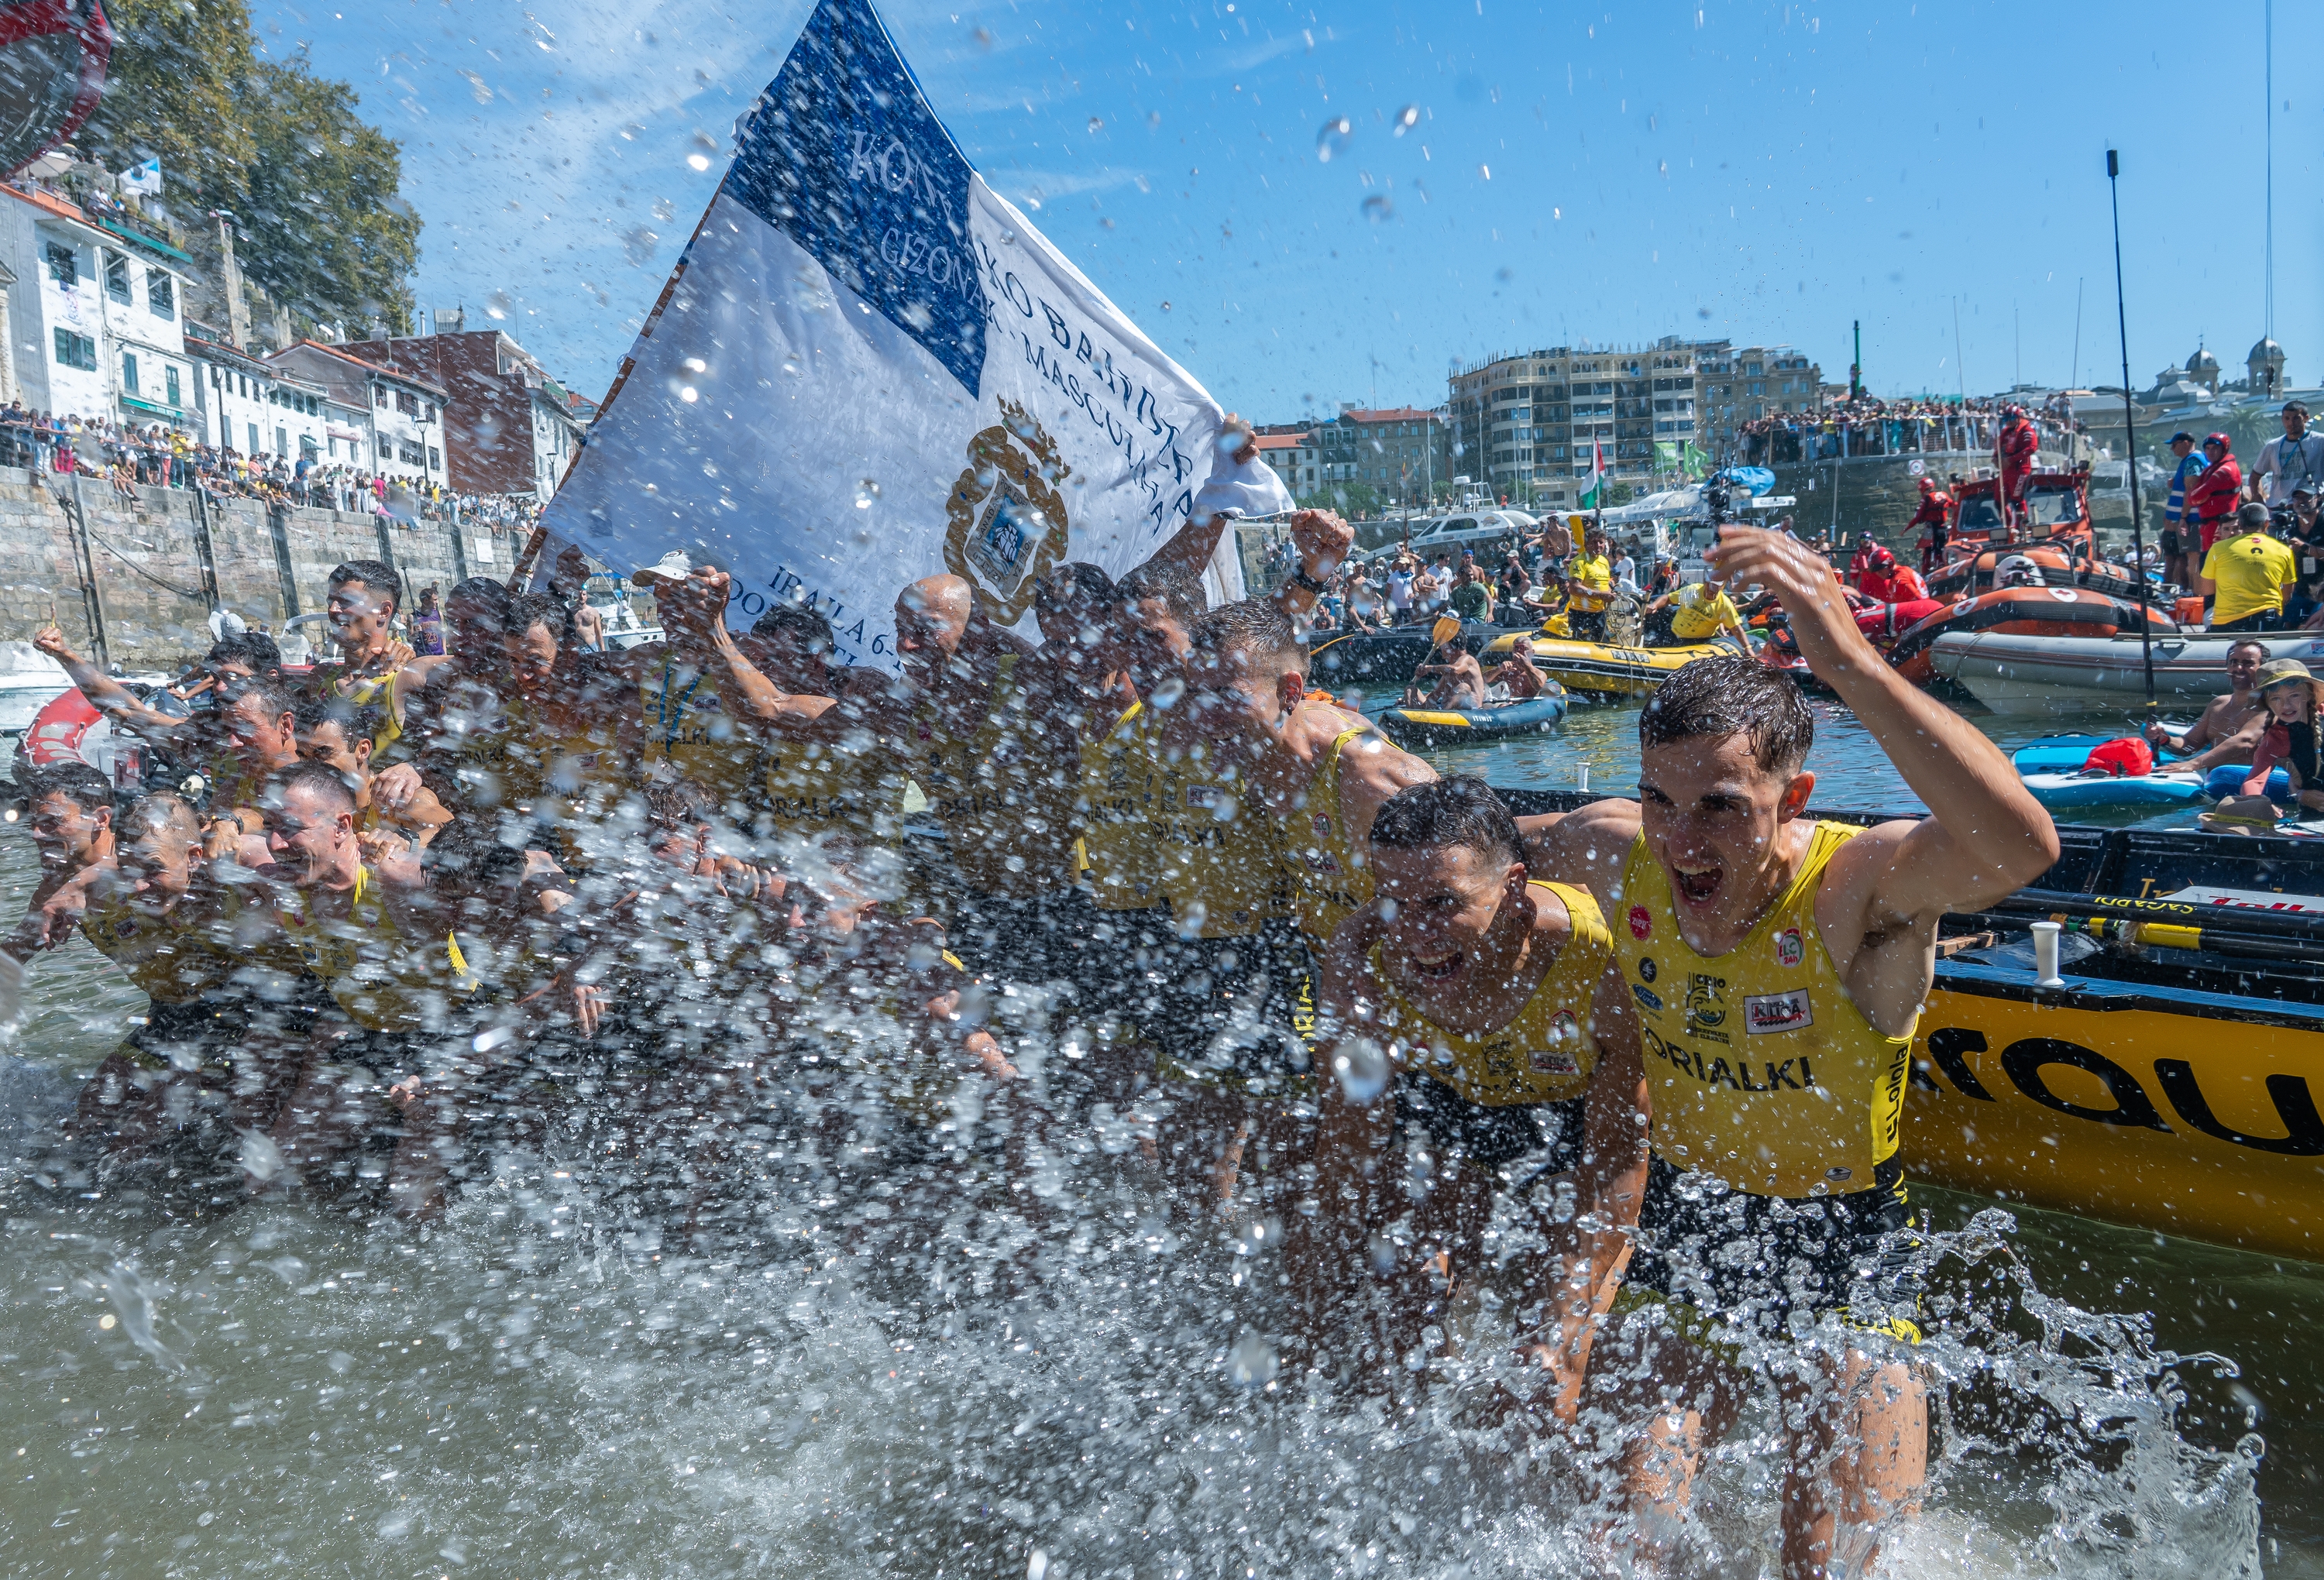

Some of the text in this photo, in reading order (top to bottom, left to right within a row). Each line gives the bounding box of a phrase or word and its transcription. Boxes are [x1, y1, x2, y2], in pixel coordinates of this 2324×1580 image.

[1779, 941, 1797, 958] ELC
[1784, 955, 1798, 965] 24h
[1695, 974, 1727, 989] ORIO
[1769, 1004, 1802, 1018] LIGA
[1643, 1026, 1813, 1092] ORIALKI
[1886, 1045, 1909, 1122] Loiola
